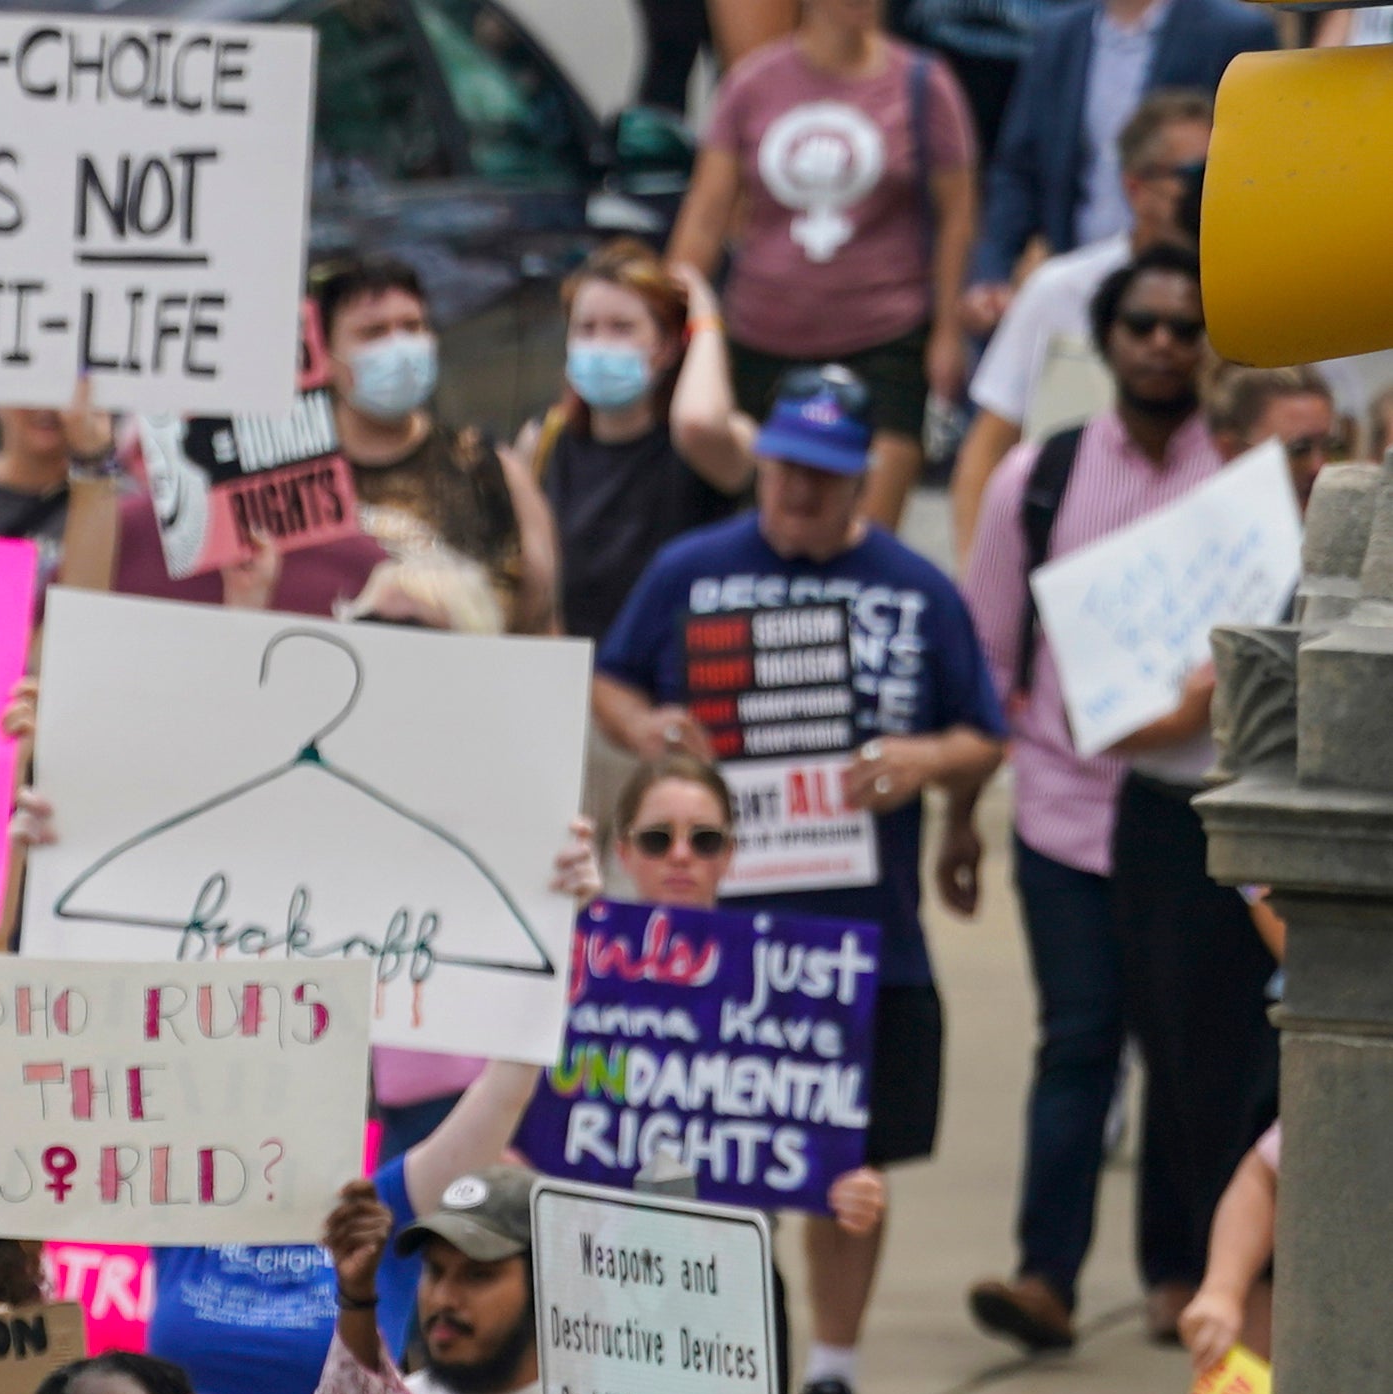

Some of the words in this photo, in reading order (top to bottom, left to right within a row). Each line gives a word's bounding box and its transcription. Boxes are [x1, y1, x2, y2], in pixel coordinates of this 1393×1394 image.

[75, 150, 217, 245] NOT
[752, 914, 876, 1022] just
[144, 981, 331, 1049] RUNS
[570, 1003, 701, 1044] anna
[22, 1062, 169, 1121] THE
[547, 1040, 870, 1130] UNDAMENTAL
[563, 1101, 813, 1193] RIGHTS
[578, 1231, 666, 1288] Weapons
[680, 1252, 720, 1297] and
[550, 1306, 667, 1367] Destructive
[679, 1326, 758, 1382] Devices
